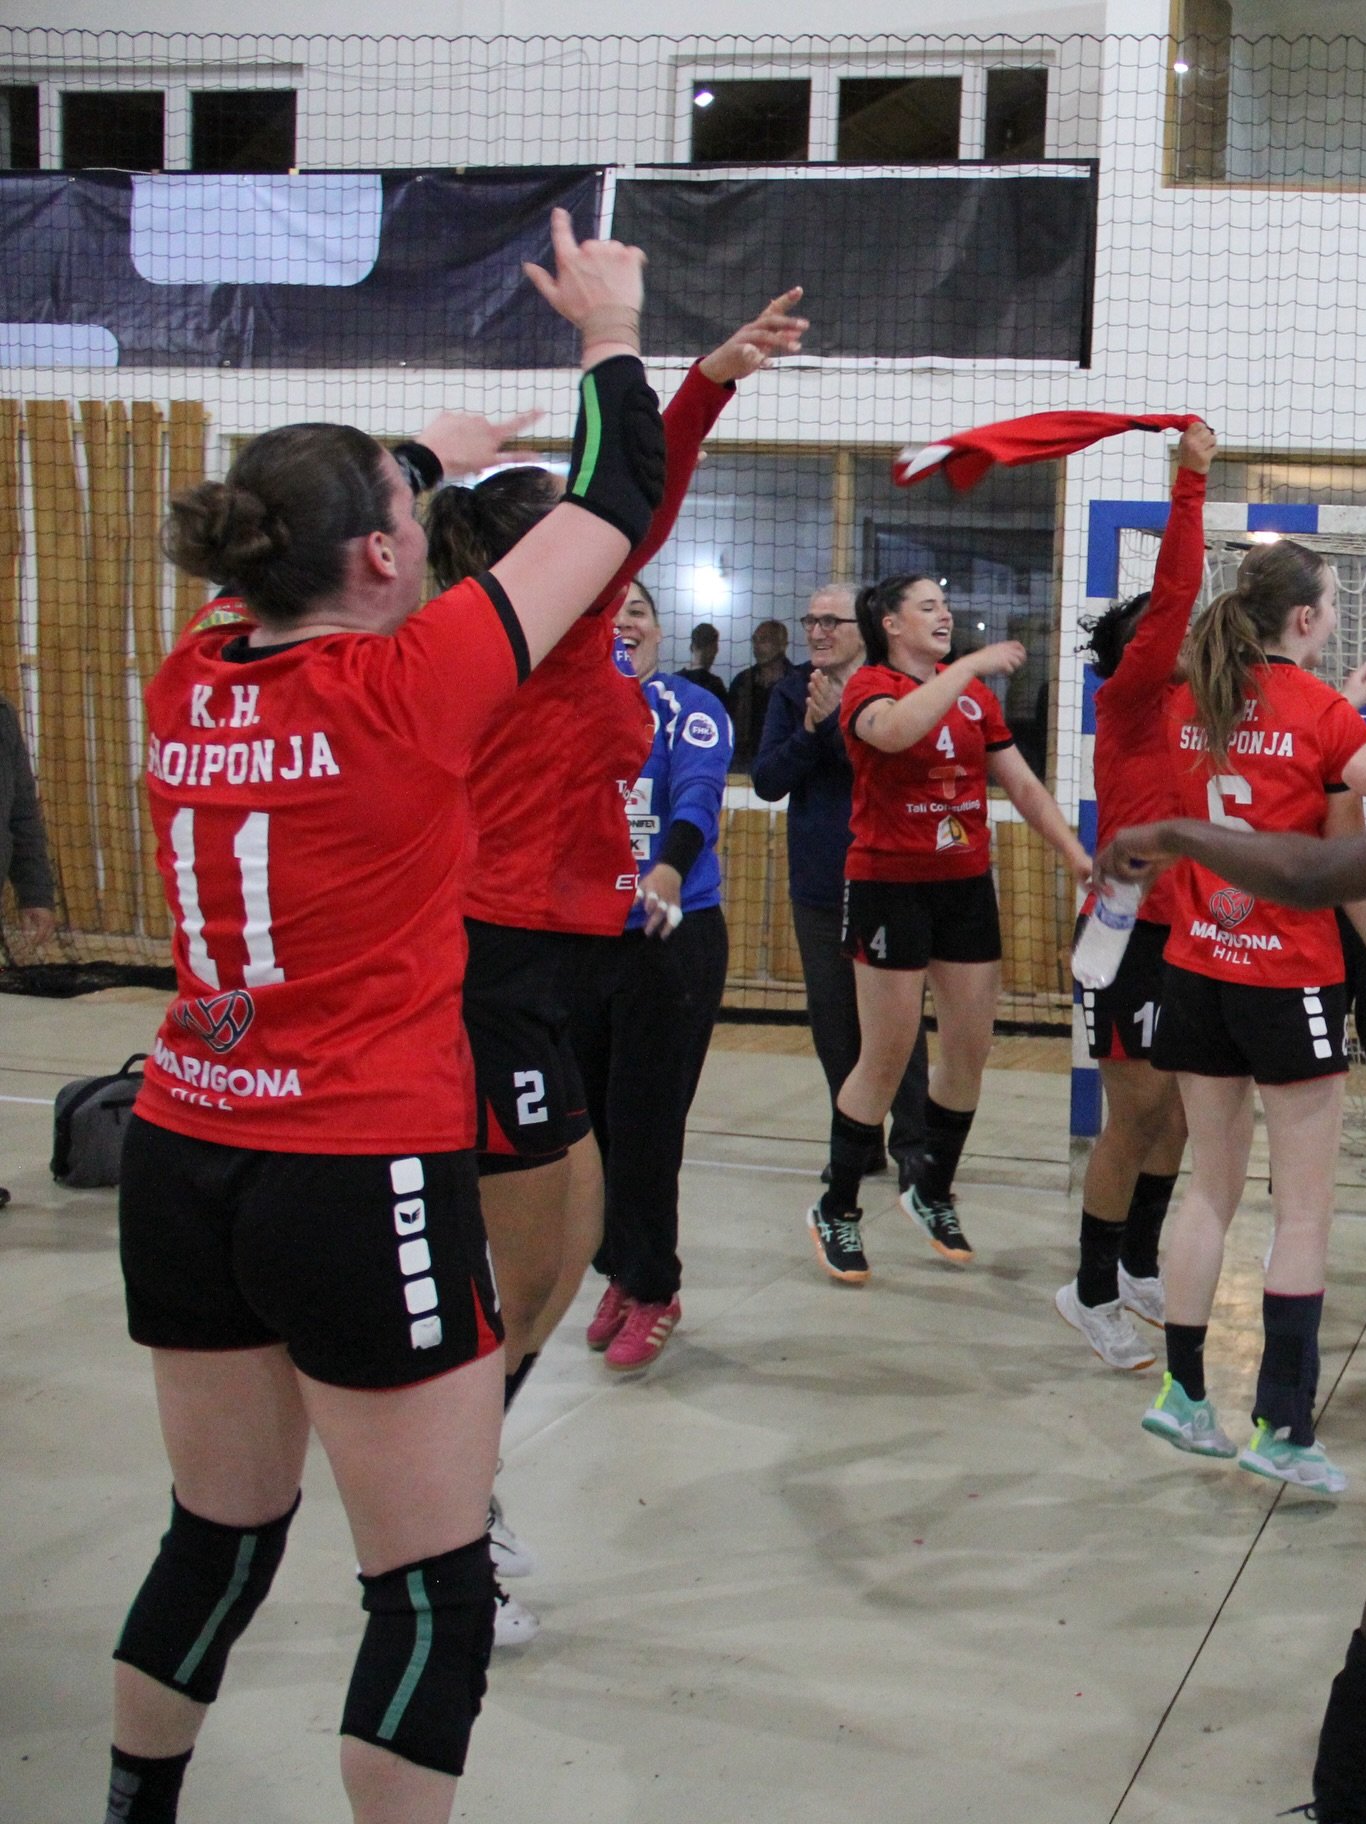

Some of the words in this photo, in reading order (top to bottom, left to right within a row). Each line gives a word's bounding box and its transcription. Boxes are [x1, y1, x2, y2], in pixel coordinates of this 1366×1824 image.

[936, 726, 955, 759] 4
[170, 807, 285, 990] 11
[870, 926, 887, 959] 4
[1213, 945, 1251, 965] HILL
[1133, 1001, 1161, 1048] 1
[154, 1037, 303, 1098] MARIGONA
[513, 1069, 549, 1126] 2
